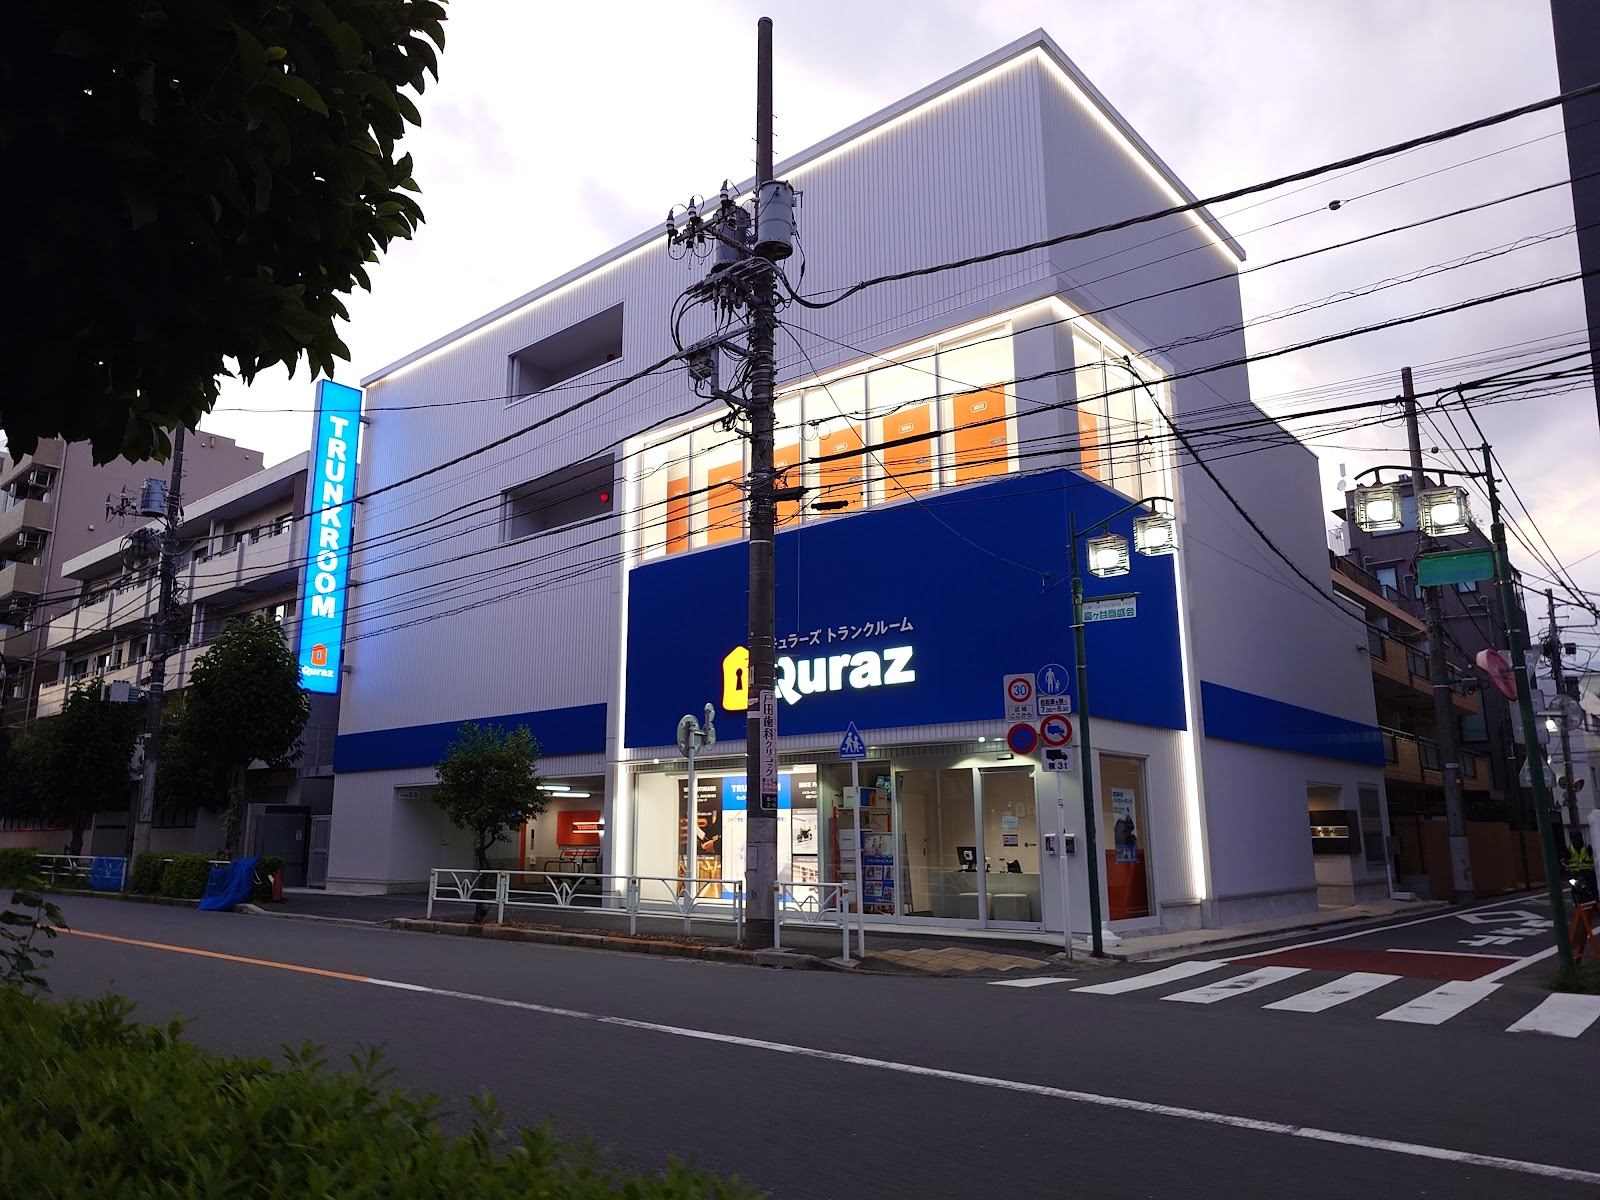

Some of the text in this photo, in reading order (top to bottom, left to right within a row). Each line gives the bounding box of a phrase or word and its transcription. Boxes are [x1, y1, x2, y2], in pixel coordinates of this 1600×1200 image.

[311, 415, 349, 619] TRUNKROOM
[827, 617, 914, 643] トランクルーム
[301, 665, 334, 678] Quraz
[1013, 684, 1027, 696] 30
